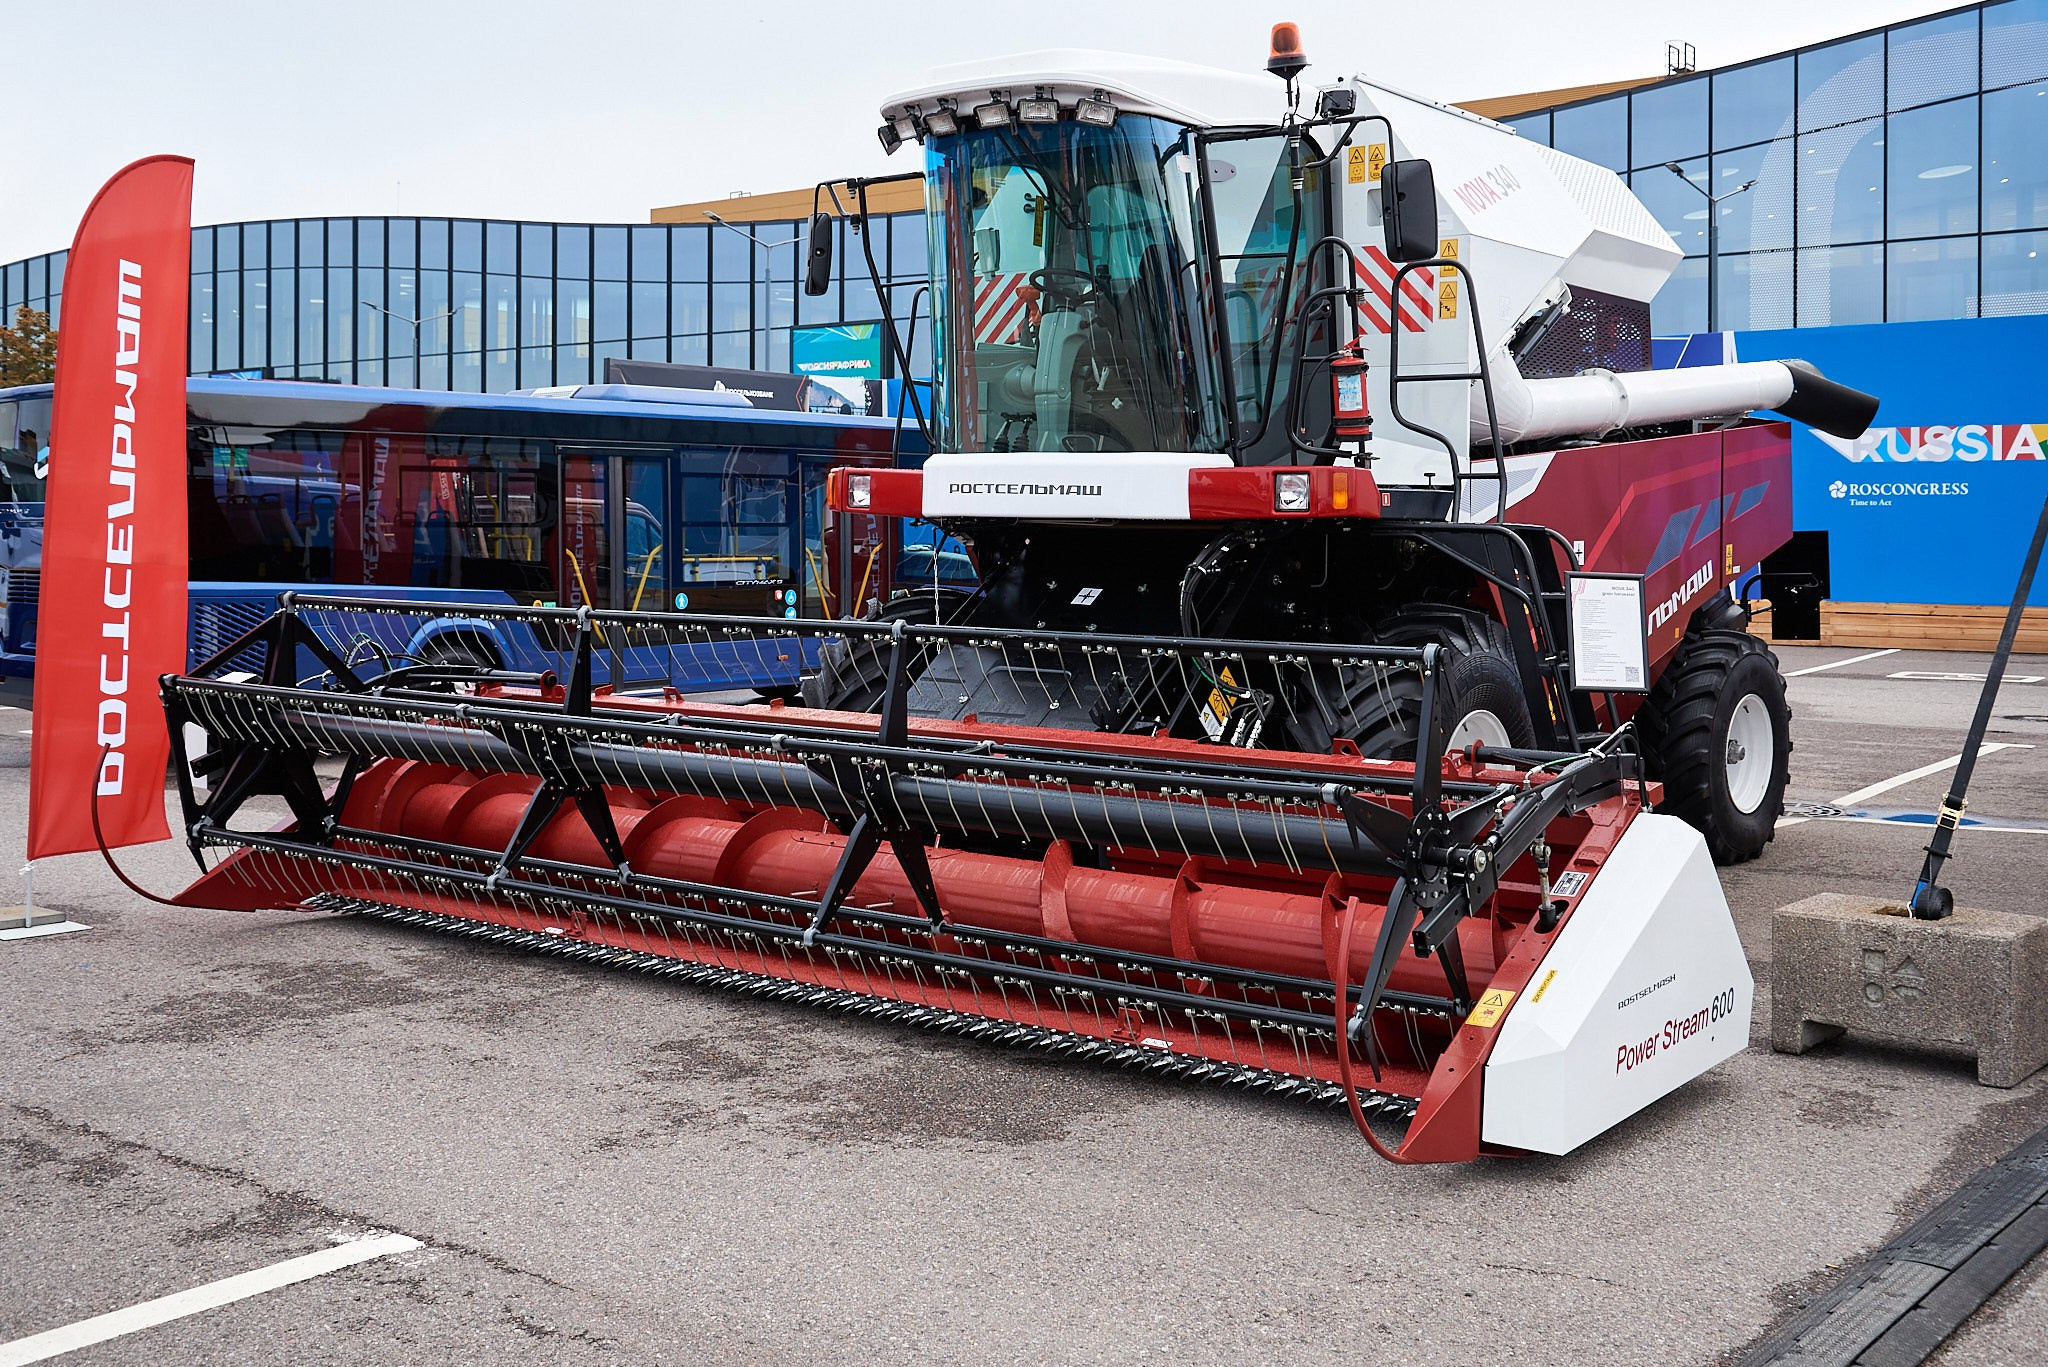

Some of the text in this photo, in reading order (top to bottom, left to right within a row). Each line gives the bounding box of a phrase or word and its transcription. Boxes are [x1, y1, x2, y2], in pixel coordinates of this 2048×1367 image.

[1453, 164, 1521, 215] NOVA 340
[1852, 424, 2046, 463] RUSSIA
[949, 483, 1102, 496] РОСТСЕЛЬМАШ
[1850, 483, 1969, 496] ROSCONGRESS
[1648, 559, 1713, 637] ЛЬМАШ
[1618, 973, 1676, 1010] ROSTSELMASH
[1616, 986, 1735, 1078] Power Stream 600
